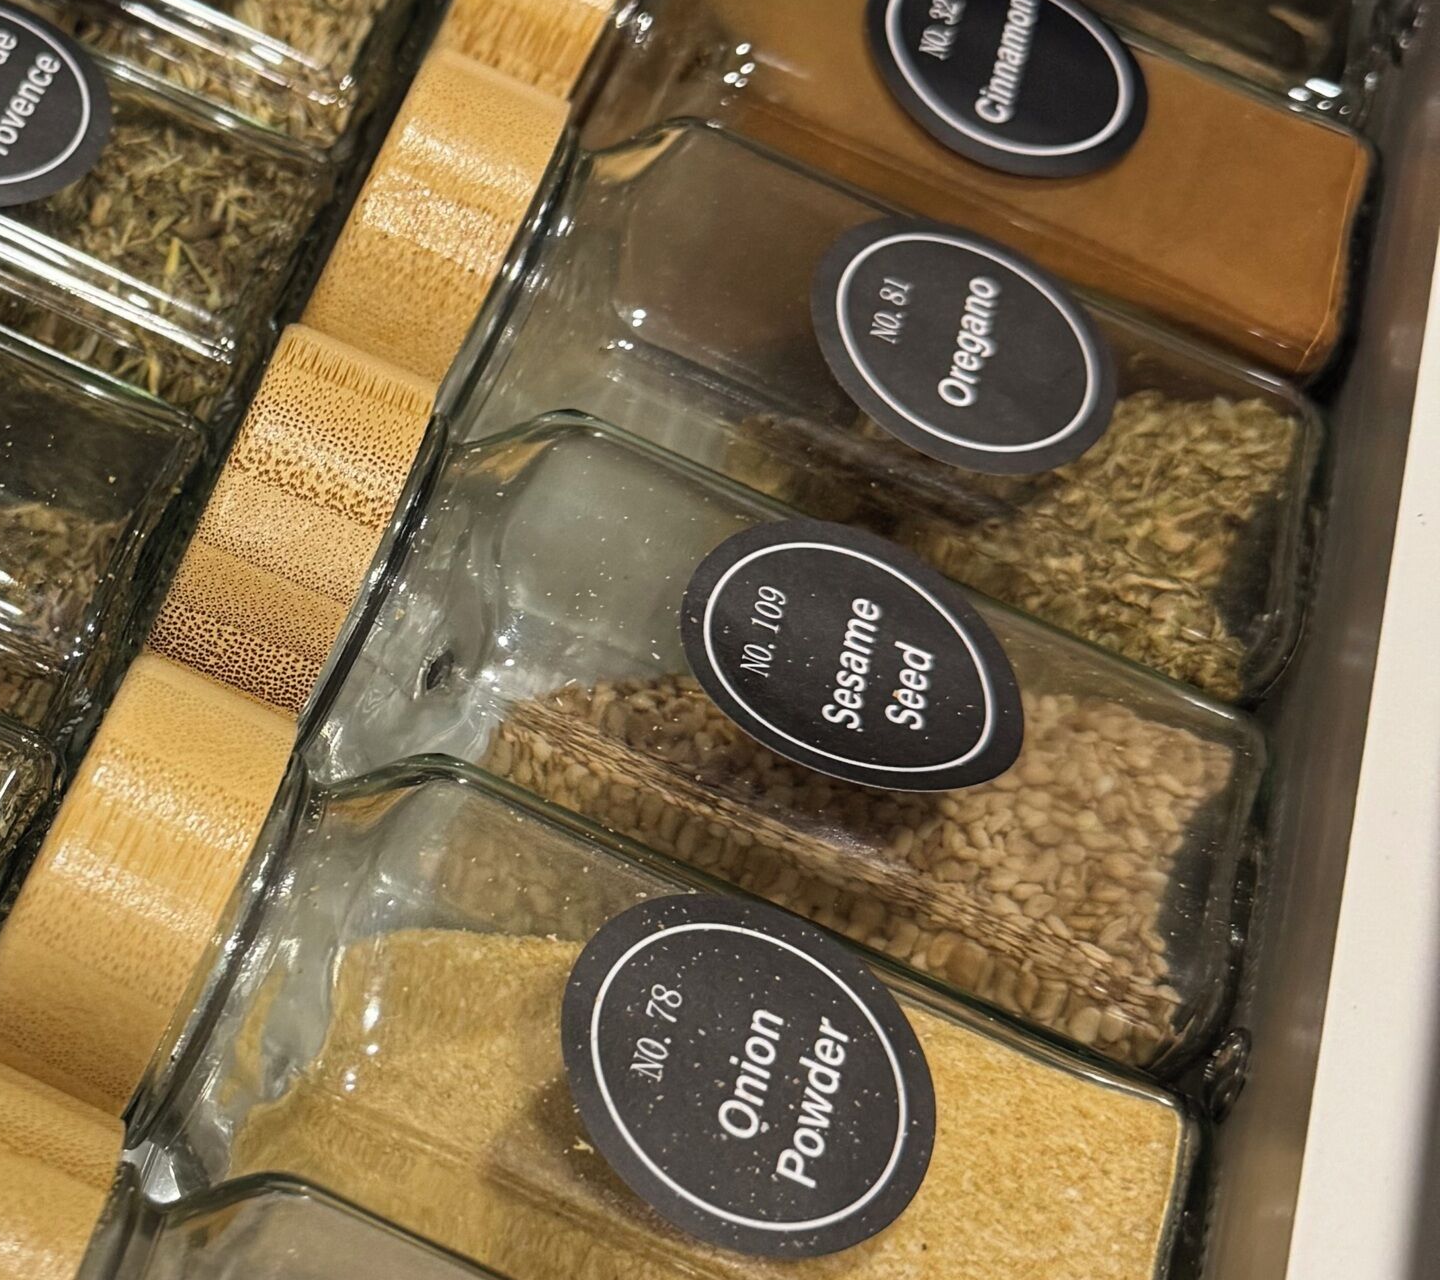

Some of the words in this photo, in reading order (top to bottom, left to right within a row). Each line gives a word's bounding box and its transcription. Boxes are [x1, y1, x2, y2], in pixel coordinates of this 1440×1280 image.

[918, 27, 954, 60] NO.
[879, 277, 912, 306] 81
[869, 311, 903, 344] NO.
[937, 277, 998, 407] Oregano
[750, 585, 787, 634] 109
[739, 643, 777, 678] NO.
[821, 598, 881, 730] Sesame
[884, 640, 934, 730] Seed
[645, 983, 683, 1023] 78
[629, 1037, 672, 1083] NO.
[717, 1009, 784, 1139] Onion
[775, 1016, 849, 1189] Powder
